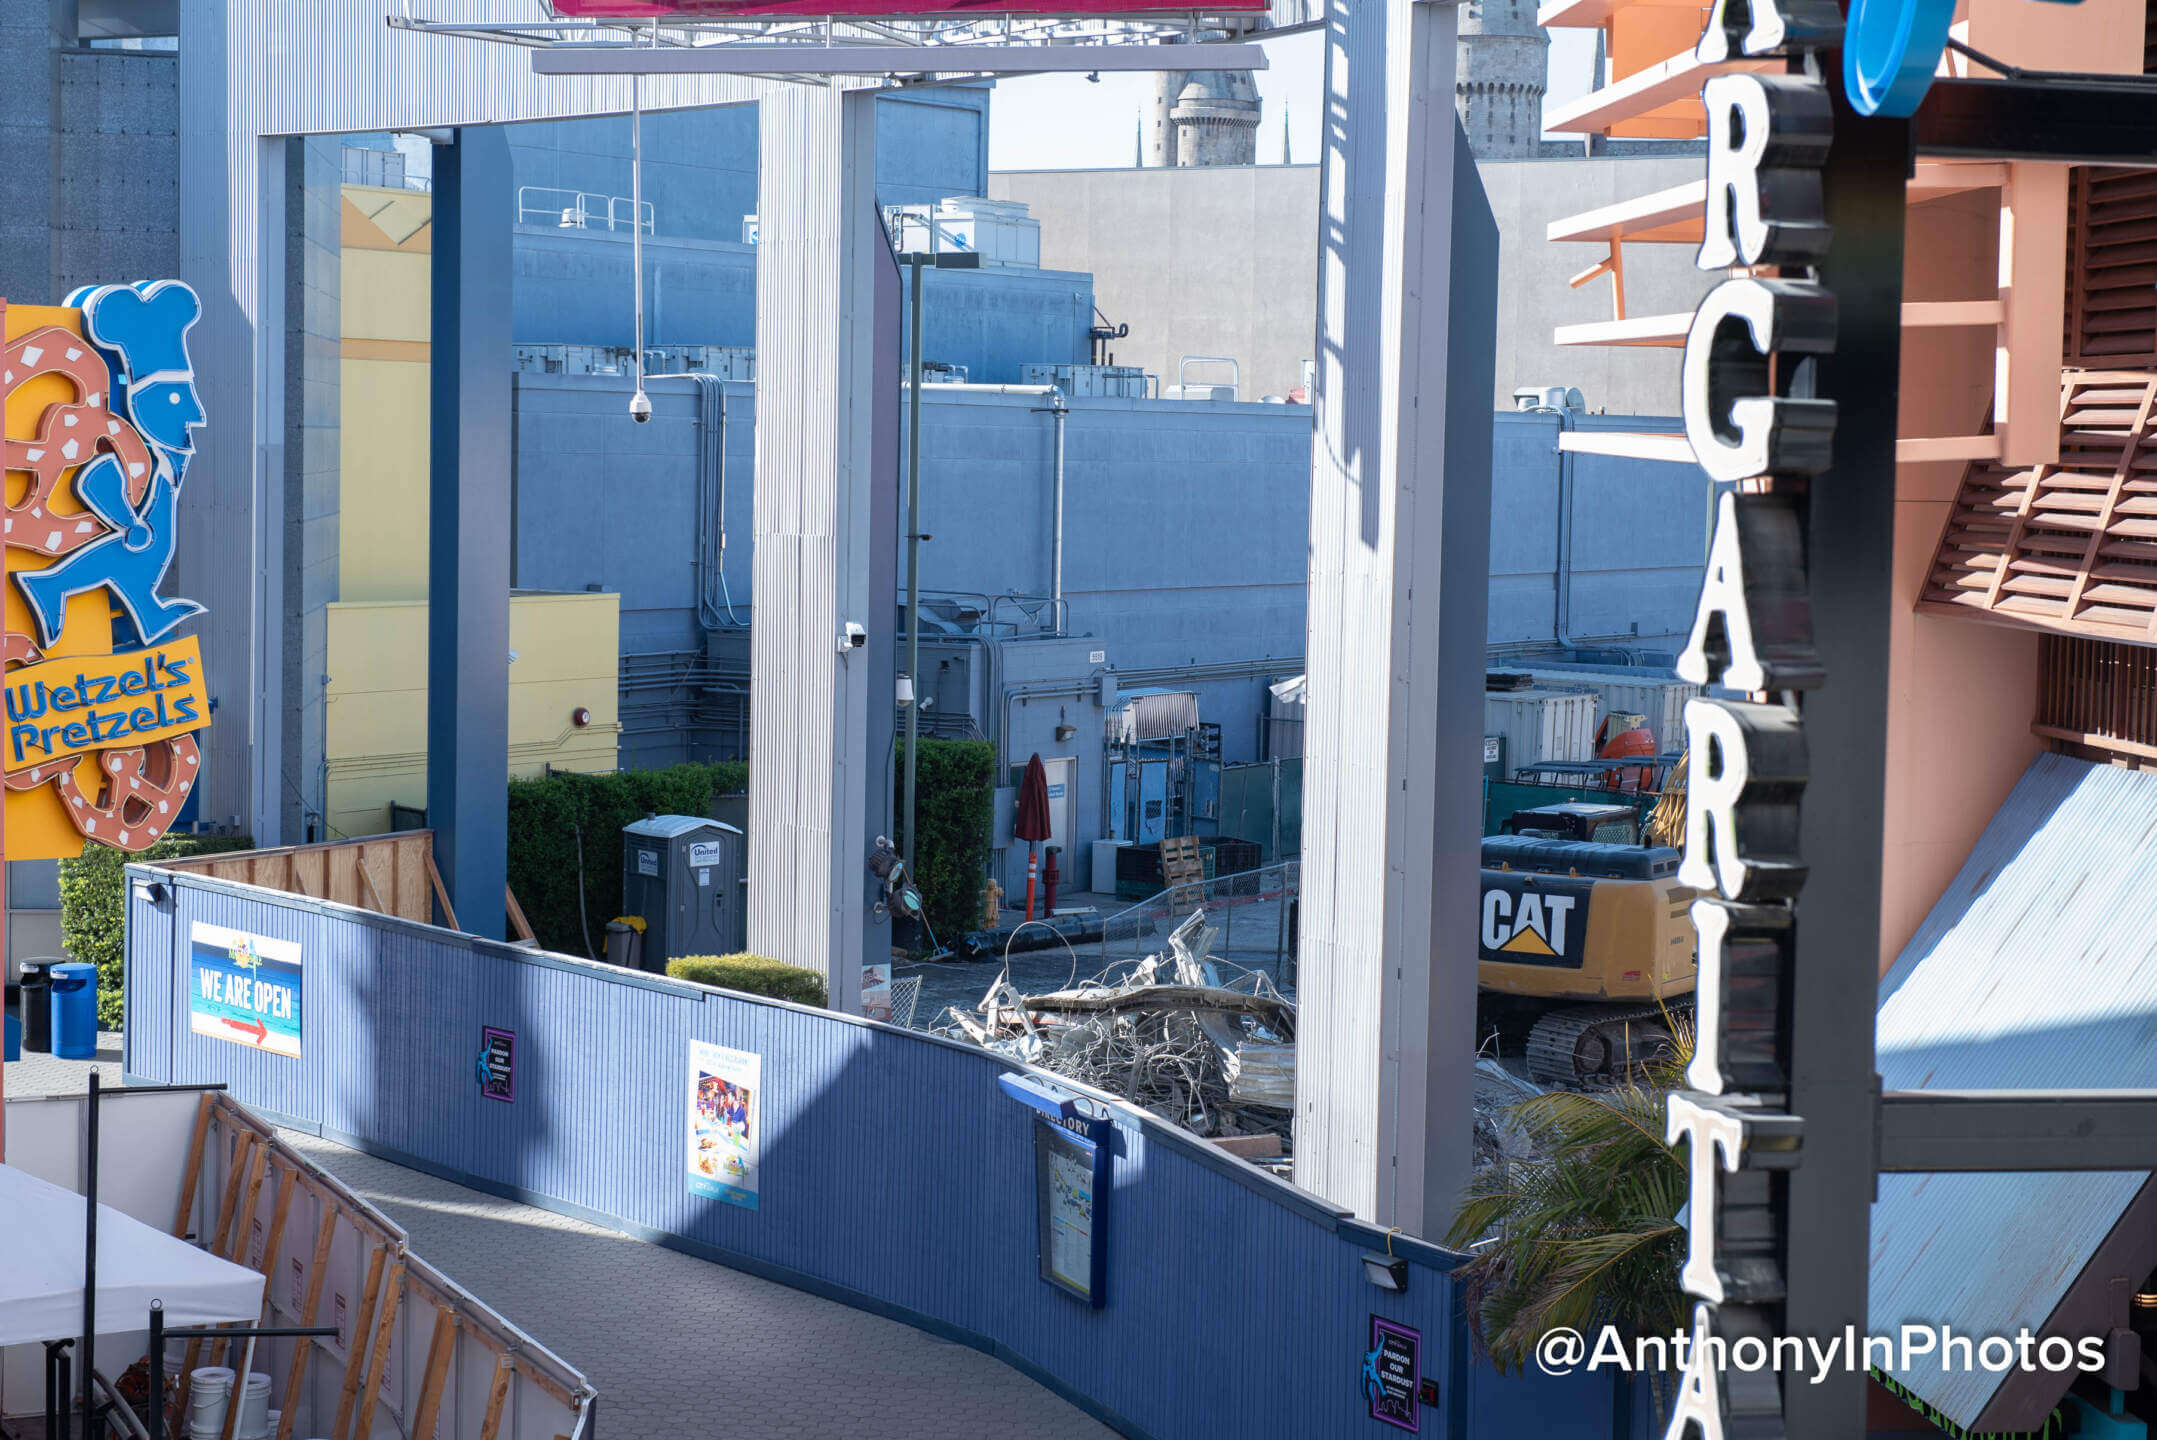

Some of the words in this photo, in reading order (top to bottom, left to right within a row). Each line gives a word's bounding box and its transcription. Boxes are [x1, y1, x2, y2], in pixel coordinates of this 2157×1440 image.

[5, 654, 191, 722] Wetzel's
[11, 693, 199, 762] Pretzels
[694, 846, 718, 856] United
[1482, 889, 1576, 957] CAT
[200, 967, 222, 1002] WE
[224, 974, 252, 1010] ARE
[253, 981, 292, 1020] OPEN
[1383, 1349, 1410, 1366] PARDON
[1389, 1362, 1404, 1374] OUR
[1381, 1370, 1413, 1388] STARDUST
